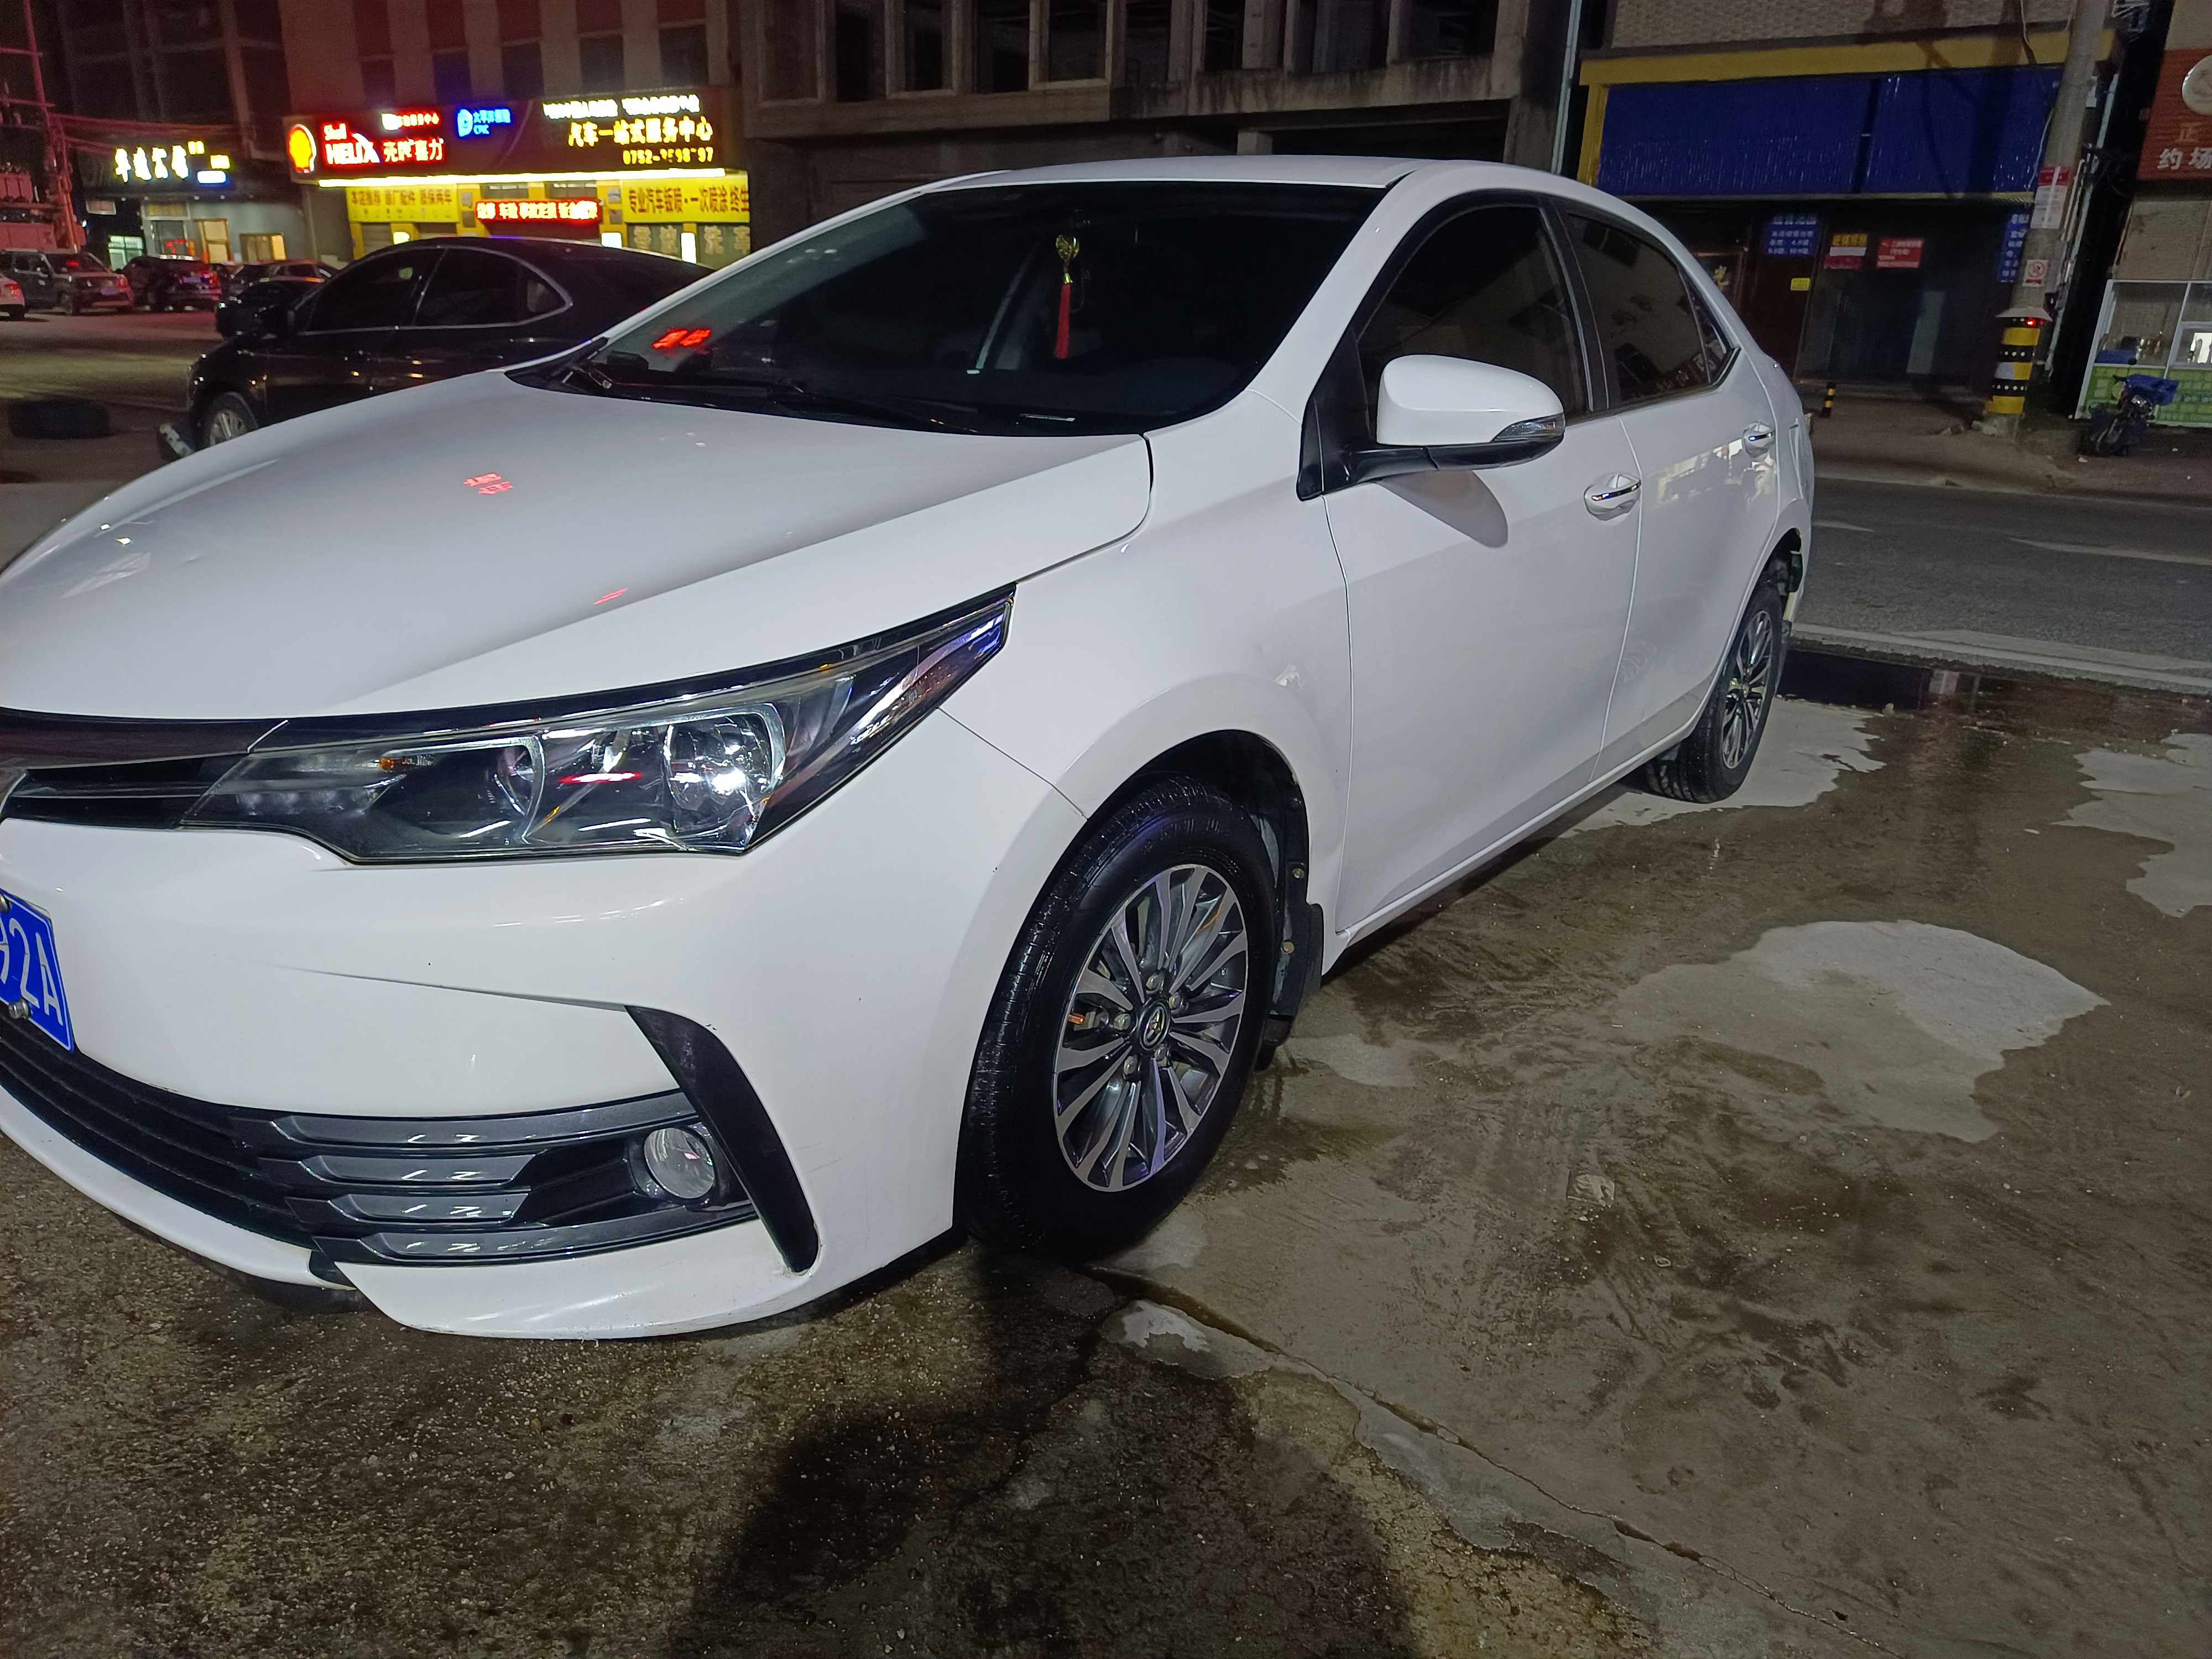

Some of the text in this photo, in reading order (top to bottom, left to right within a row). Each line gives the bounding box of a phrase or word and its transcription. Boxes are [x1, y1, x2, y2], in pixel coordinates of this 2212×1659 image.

[568, 116, 713, 147] 汽车一站式服务中心
[325, 135, 380, 164] HELIX
